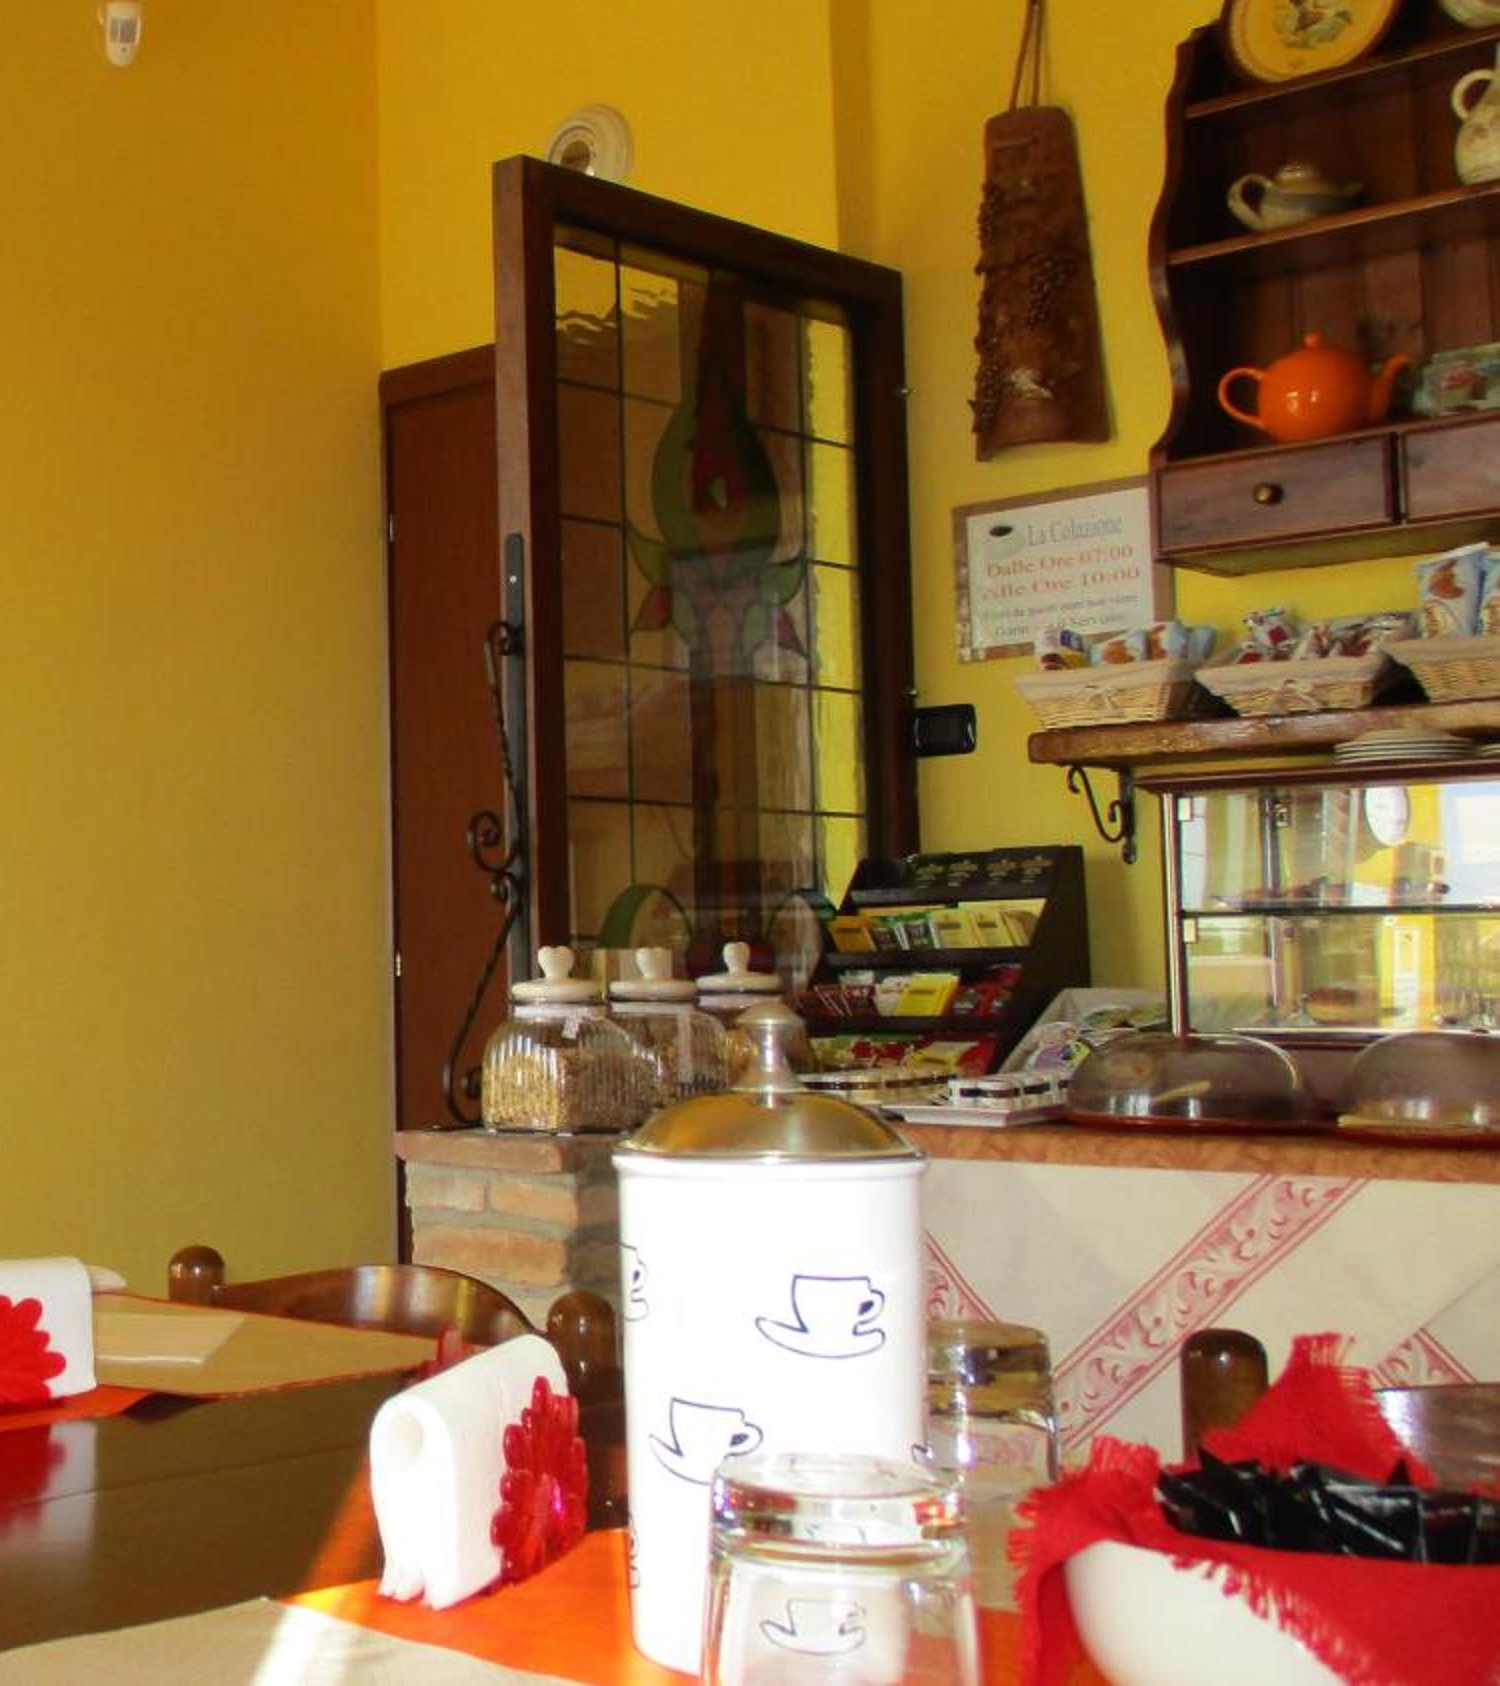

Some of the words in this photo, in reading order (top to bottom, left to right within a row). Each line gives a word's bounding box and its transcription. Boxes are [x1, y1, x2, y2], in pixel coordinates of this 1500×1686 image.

[1028, 523, 1046, 546] La
[1050, 513, 1122, 542] Colazione
[986, 558, 1034, 578] Dalle
[1040, 553, 1075, 572] Ore
[1079, 544, 1134, 562] 07:00
[1031, 578, 1073, 595] Ore
[1080, 567, 1140, 587] 10:00
